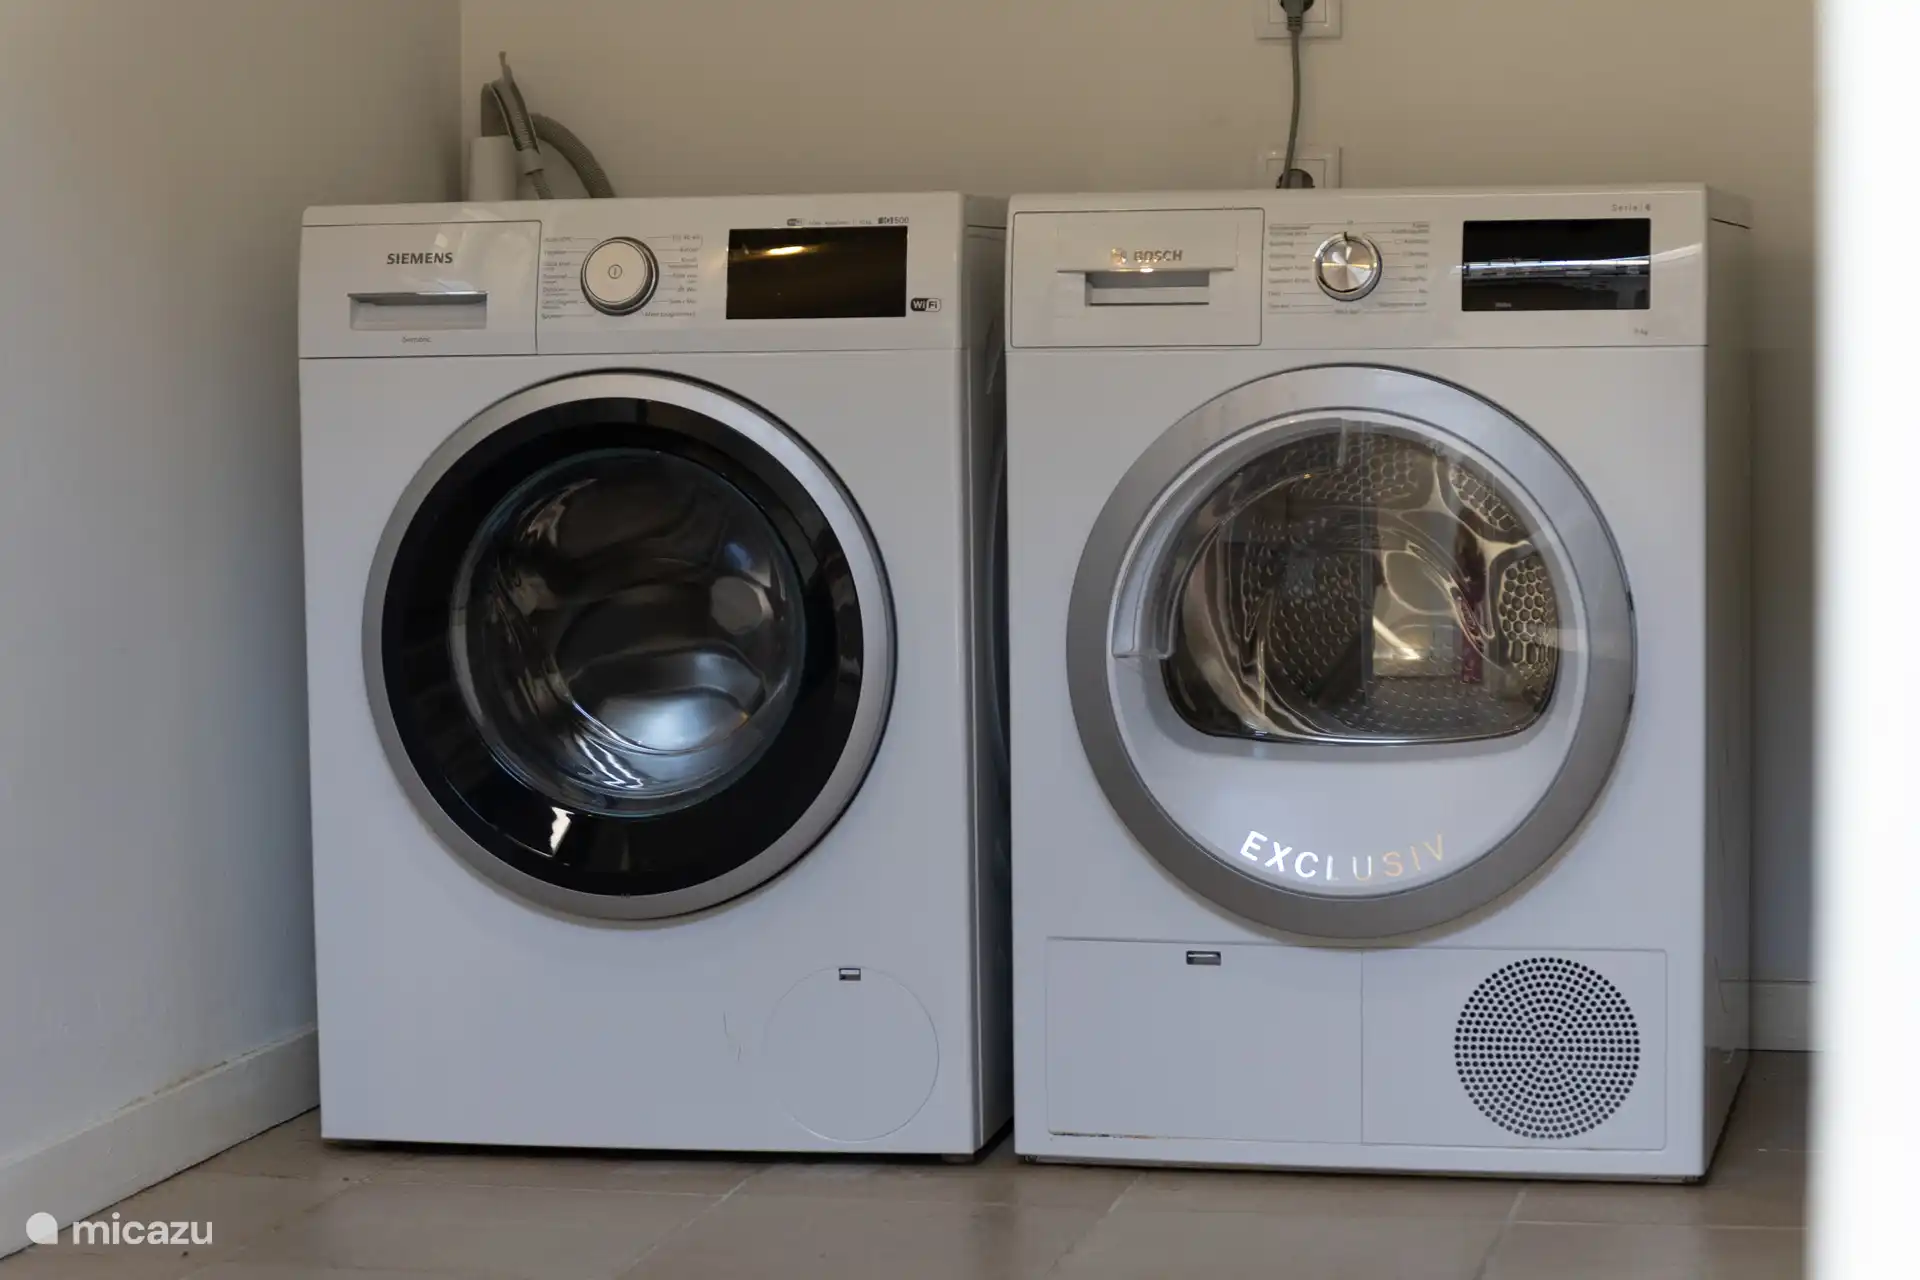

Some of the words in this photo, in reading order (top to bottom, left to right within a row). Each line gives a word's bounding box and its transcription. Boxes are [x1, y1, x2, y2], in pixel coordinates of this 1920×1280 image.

[386, 252, 453, 265] SIEMENS
[1134, 249, 1183, 262] BOSCH
[1240, 830, 1443, 881] EXCLUSIV
